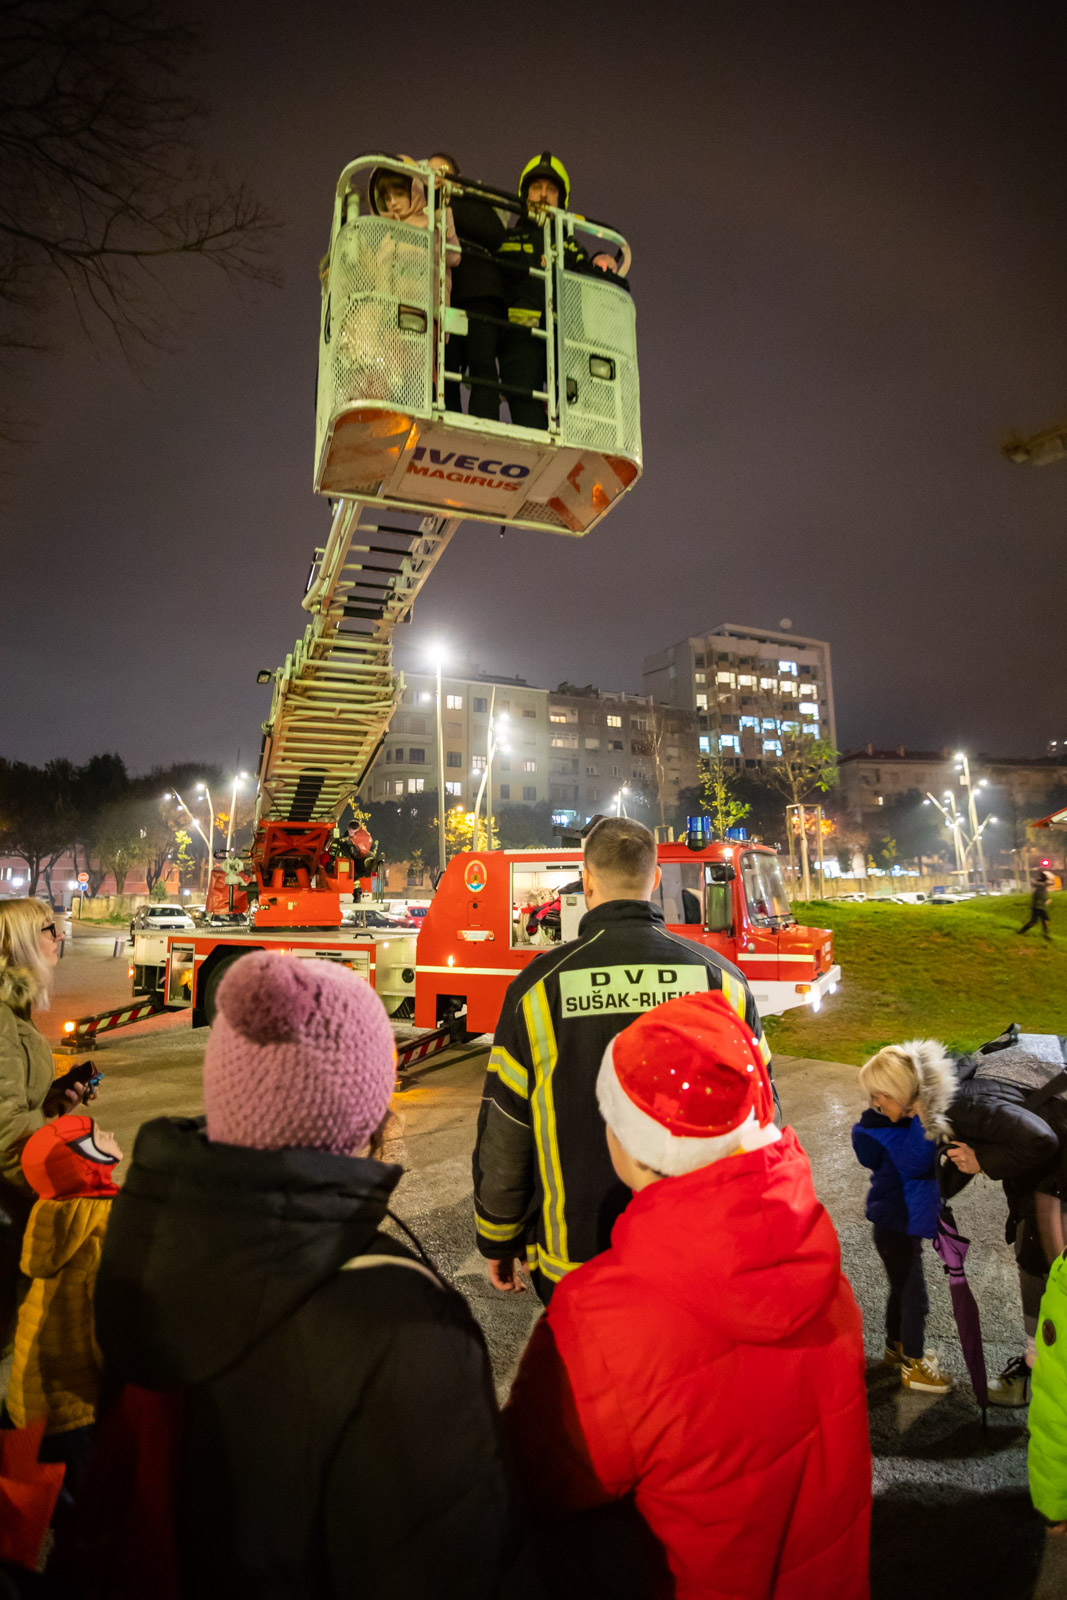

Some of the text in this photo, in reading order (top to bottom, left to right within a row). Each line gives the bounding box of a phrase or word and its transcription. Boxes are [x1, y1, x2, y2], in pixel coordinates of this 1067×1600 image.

[412, 446, 530, 479] IVECO
[406, 463, 523, 492] MAGIRUS
[566, 989, 701, 1012] SUŠAK-RIJE
